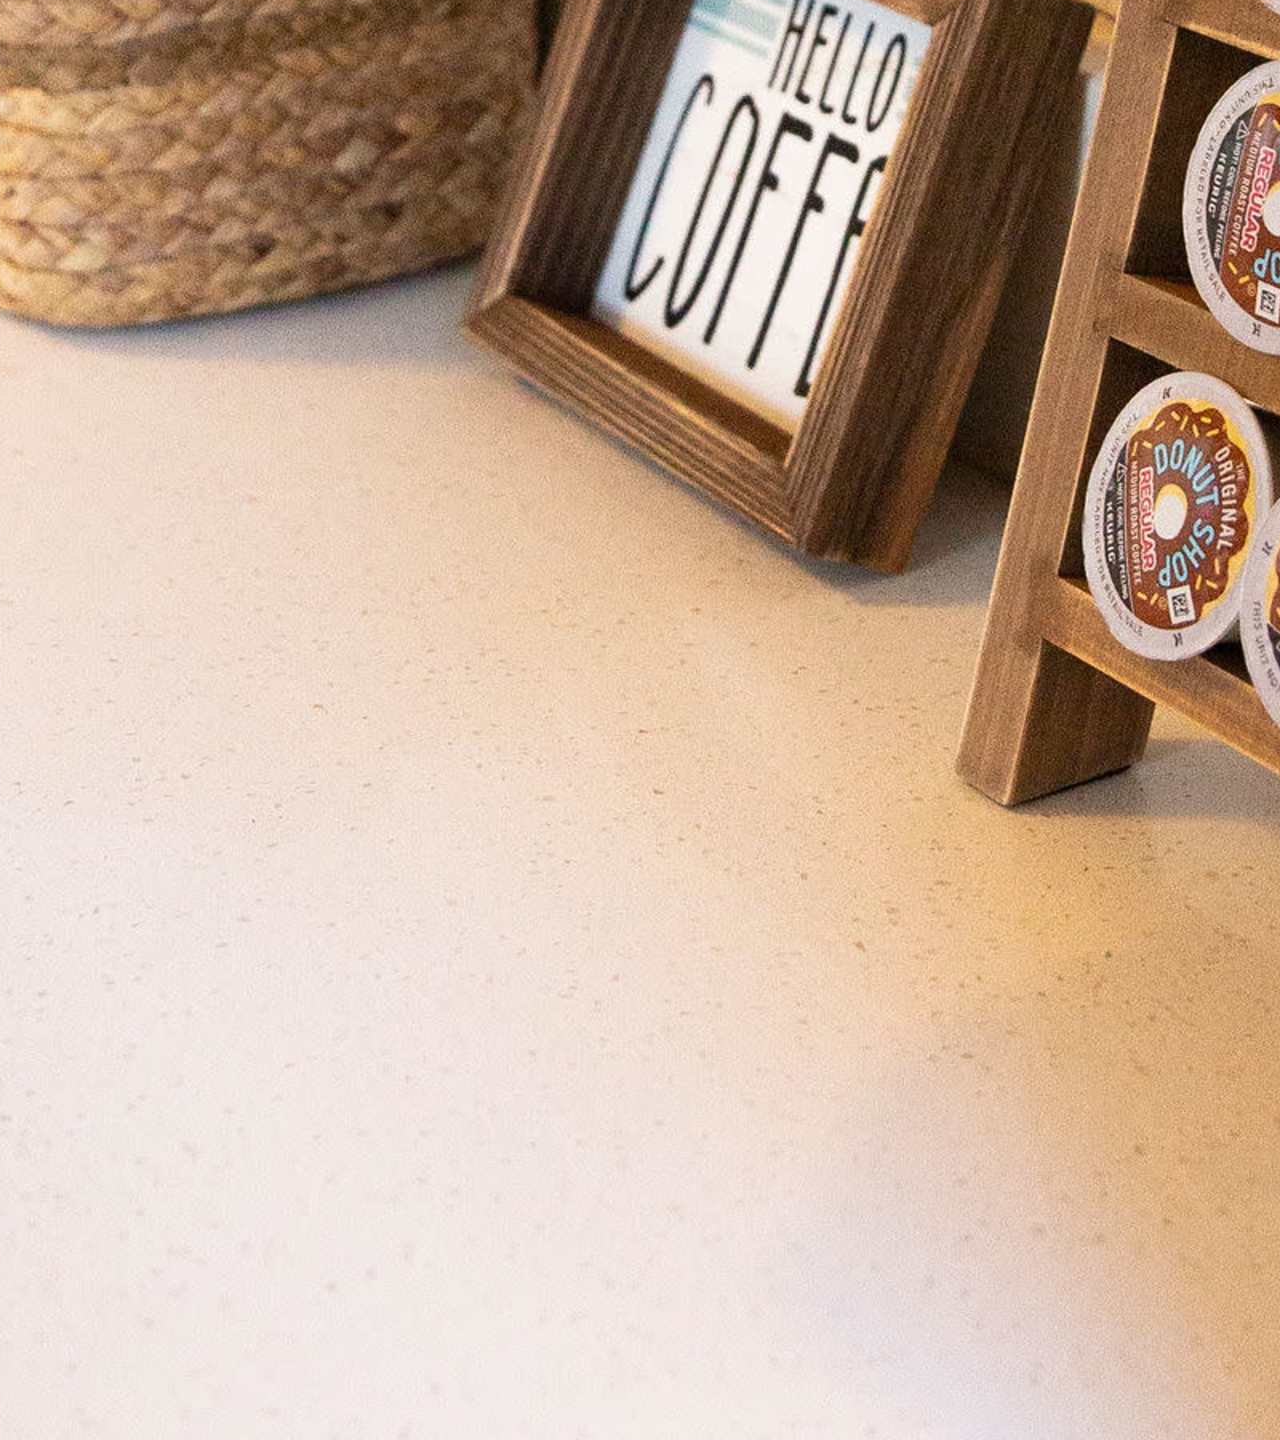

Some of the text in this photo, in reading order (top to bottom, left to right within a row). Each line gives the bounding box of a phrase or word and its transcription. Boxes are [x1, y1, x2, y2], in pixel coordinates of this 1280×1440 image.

[623, 72, 890, 399] COFFE
[1207, 152, 1228, 214] KEURIG
[1228, 130, 1263, 257] MEDIUM ROAST COFFEE
[1240, 146, 1277, 253] REGULAR
[1105, 501, 1117, 564] KEURIG
[1128, 459, 1143, 586] MEDIUM ROAST COFFEE
[1139, 466, 1158, 572] REGULAR
[1153, 438, 1219, 588] DONUT SHOP
[1214, 445, 1238, 550] ORIGINAL
